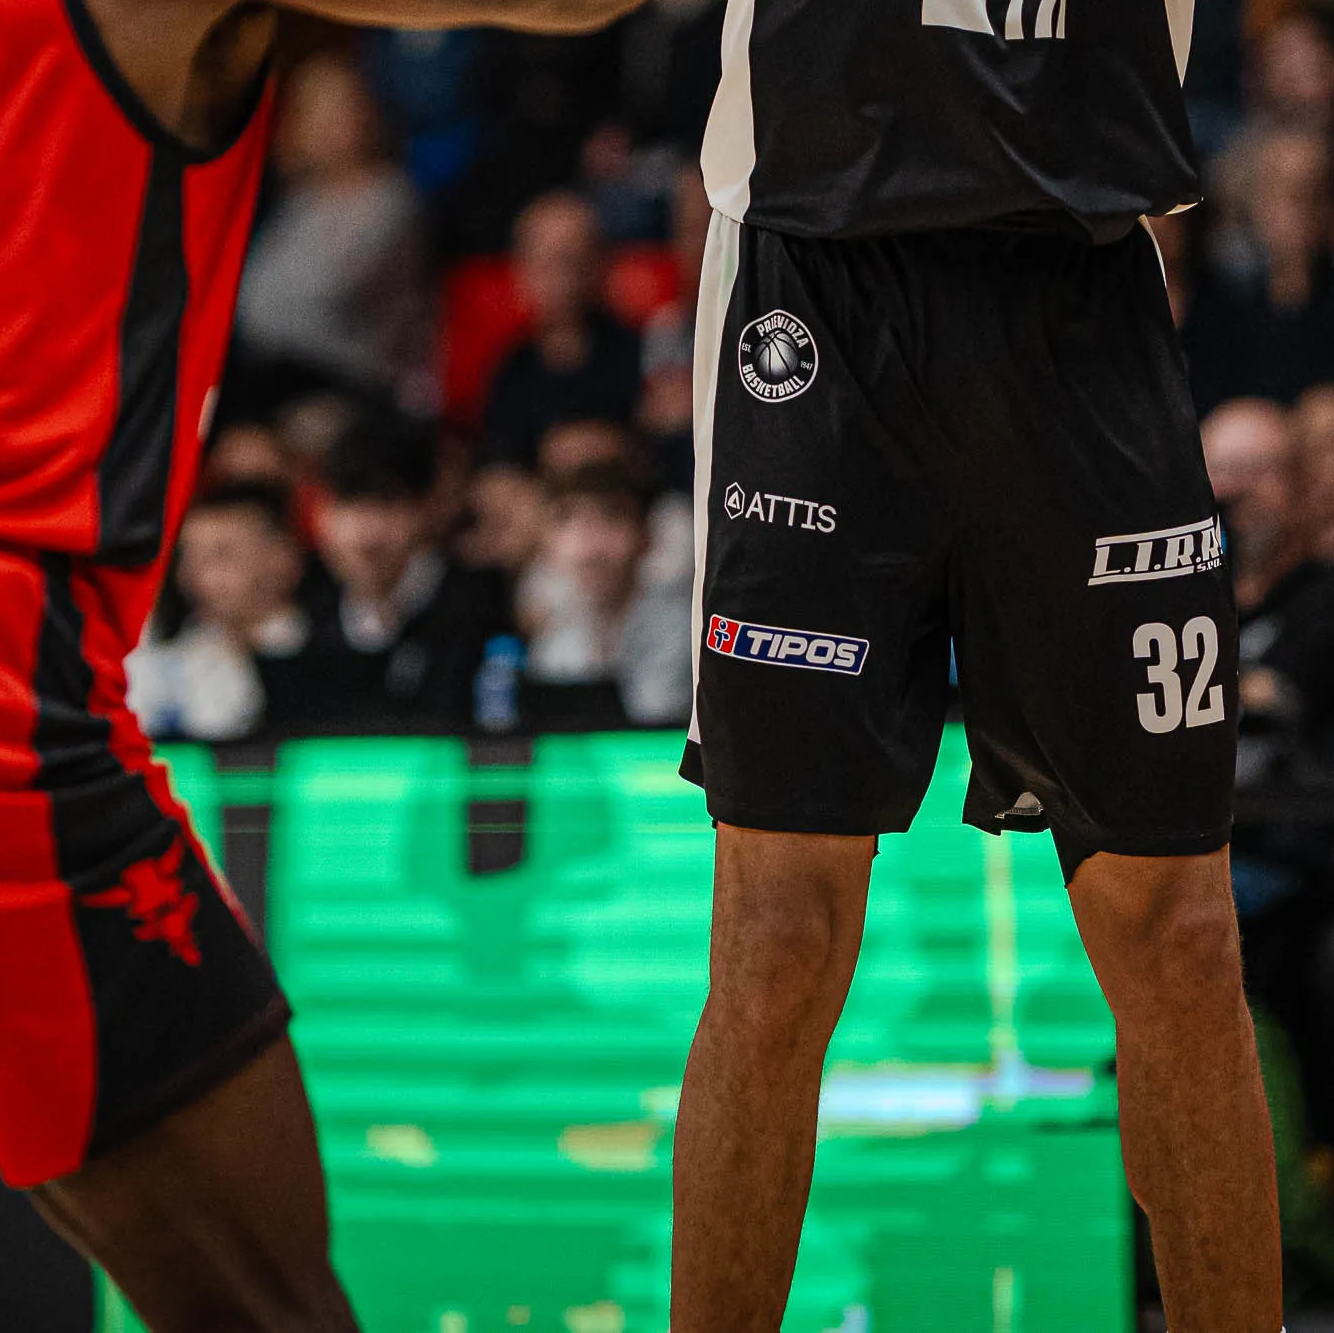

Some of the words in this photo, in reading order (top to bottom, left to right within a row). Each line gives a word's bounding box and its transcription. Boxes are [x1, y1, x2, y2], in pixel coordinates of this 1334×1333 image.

[756, 314, 810, 348] PRIEVIDZA
[742, 363, 805, 398] BASKETBALL
[800, 360, 813, 371] 1947
[745, 491, 837, 533] ATTIS
[746, 630, 859, 668] TIPOS
[1132, 615, 1225, 735] 32
